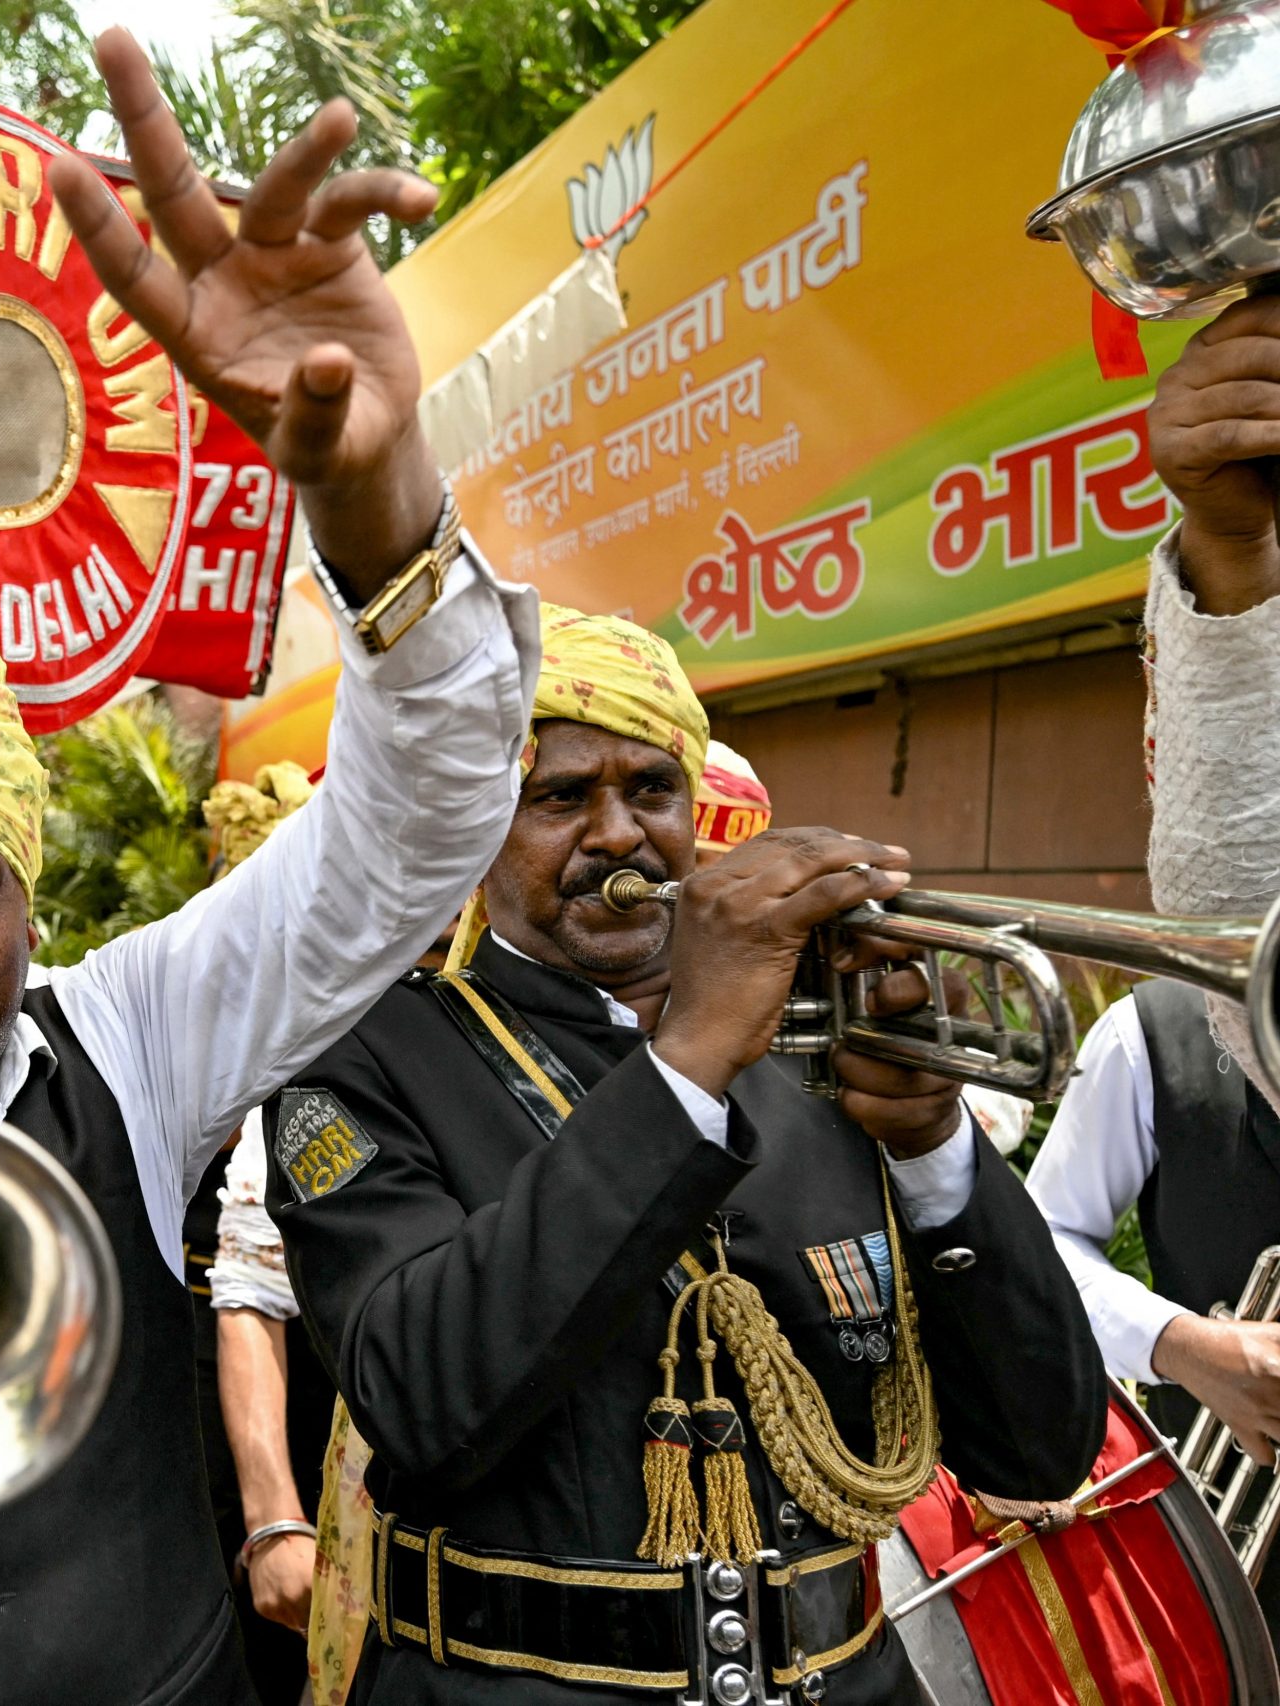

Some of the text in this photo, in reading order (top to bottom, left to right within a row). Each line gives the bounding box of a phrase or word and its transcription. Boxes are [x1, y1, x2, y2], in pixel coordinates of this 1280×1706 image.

[581, 275, 728, 406] जनता
[738, 159, 869, 313] पार्टी
[502, 357, 766, 528] केन्द्रीय कार्यालय
[736, 421, 801, 487] दिल्ली
[677, 397, 1183, 648] श्रेष्ठ भार
[0, 543, 134, 662] DELHI
[280, 1094, 322, 1149] LEGACY
[281, 1104, 338, 1168] SINCE 1965
[291, 1117, 355, 1185] HARI
[311, 1143, 362, 1196] OM
